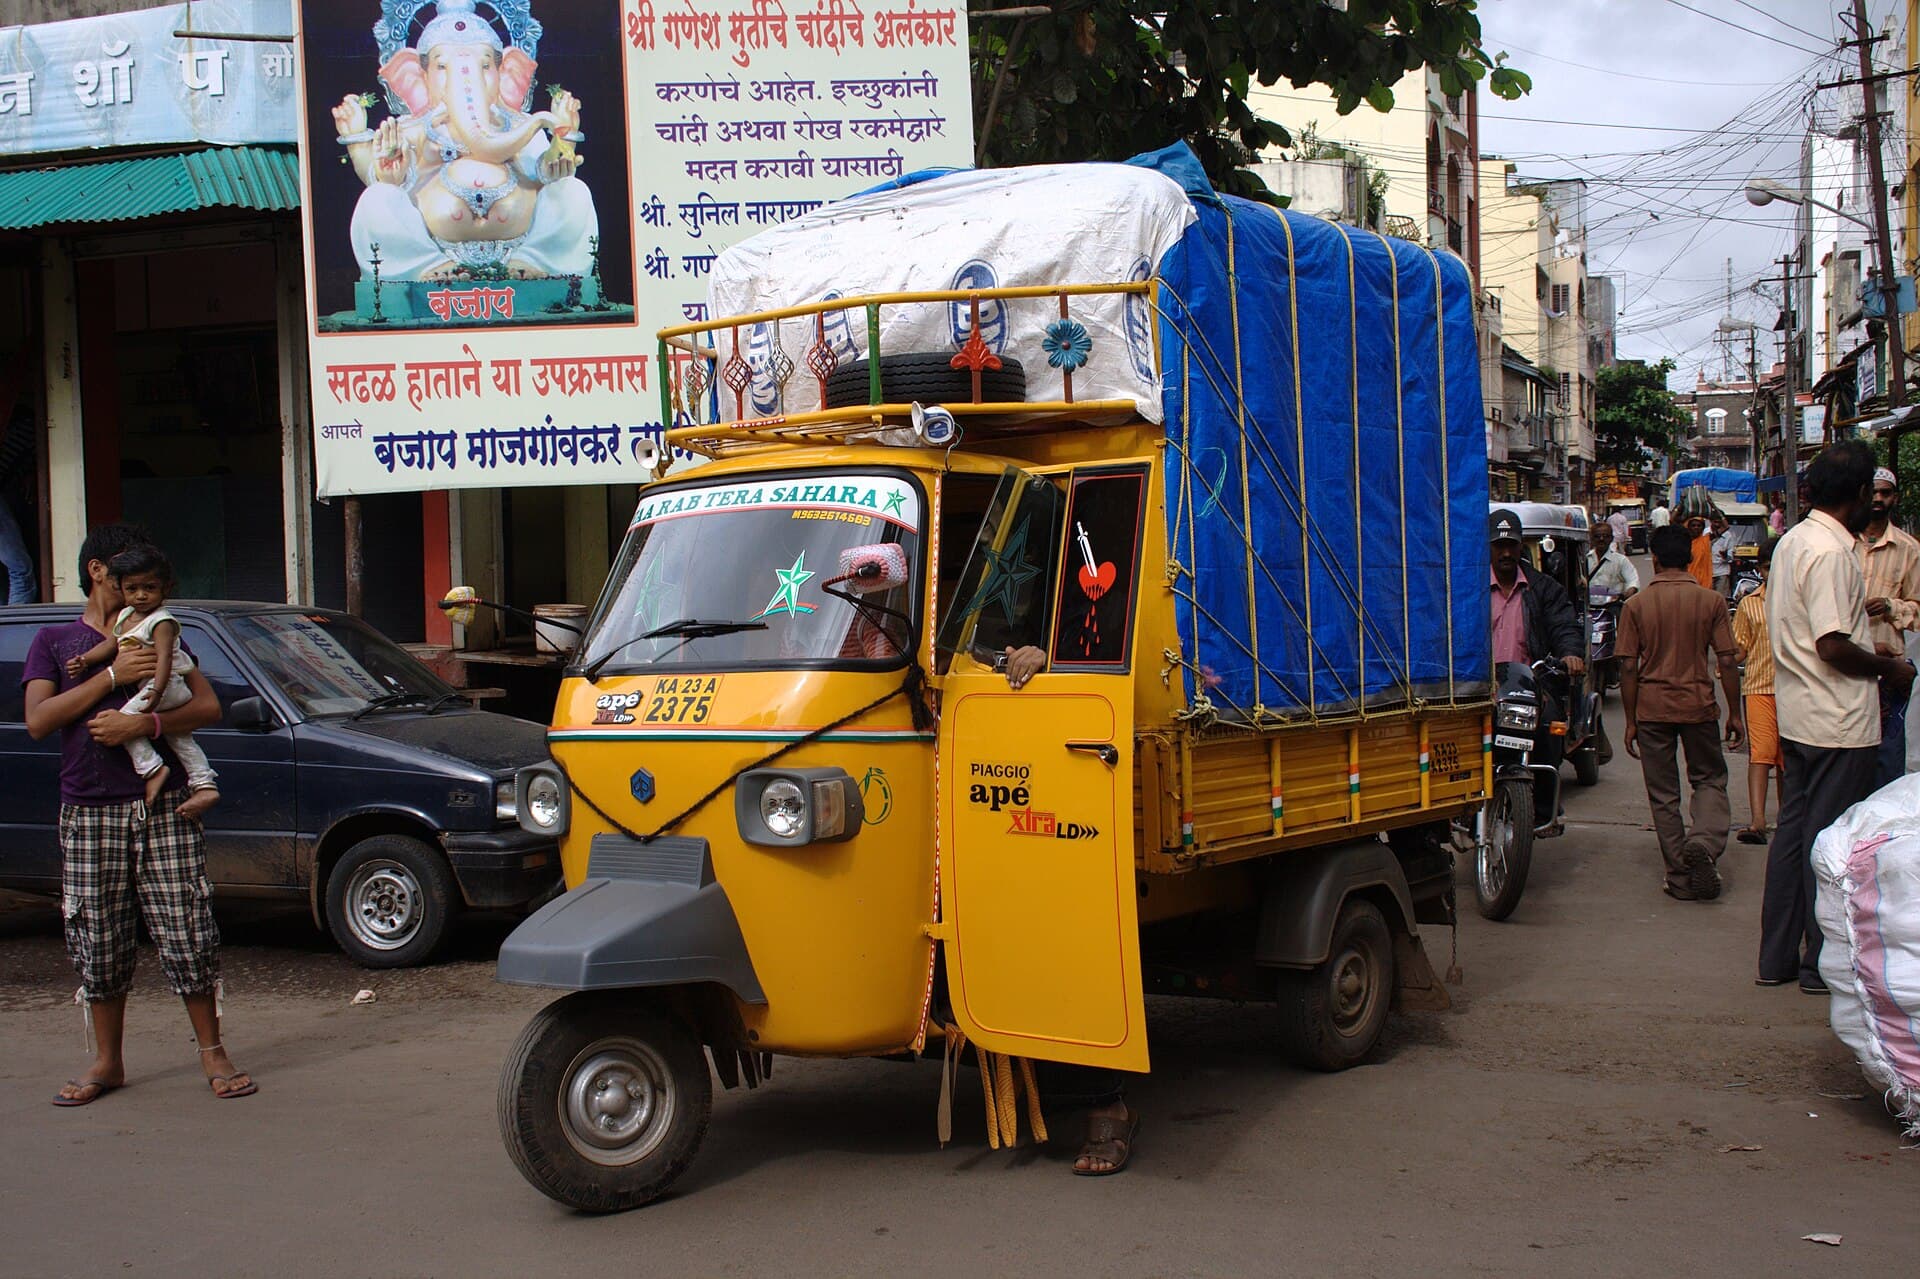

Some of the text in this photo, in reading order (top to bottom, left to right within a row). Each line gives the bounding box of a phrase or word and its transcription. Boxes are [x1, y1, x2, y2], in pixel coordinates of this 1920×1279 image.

[628, 0, 655, 50] श्री
[663, 0, 721, 50] गणेश
[795, 0, 864, 56] चांदीचे
[873, 0, 956, 48] अलंकार
[655, 70, 938, 108] करणेचे आहेत. इच्छुकांनी
[655, 107, 946, 146] चांदी अथवा रोख रकमेद्वारे
[685, 148, 904, 183] मदत करावी यासाठी
[640, 194, 671, 227] श्री.
[678, 192, 740, 238] सुनिल
[644, 246, 675, 279] श्री.
[427, 287, 515, 321] बजाप
[326, 363, 396, 404] सढळ
[405, 344, 482, 412] हाताने
[490, 359, 522, 396] या
[531, 354, 648, 396] उपक्रमास
[321, 419, 363, 440] आपले
[373, 429, 457, 473] बजाप
[466, 414, 622, 467] माजगांवकर
[655, 495, 703, 516] RAB
[704, 488, 763, 508] TERA
[769, 485, 878, 508] SAHARA
[655, 679, 678, 694] KA
[681, 679, 702, 694] 23
[645, 696, 711, 723] 2375
[971, 763, 1030, 779] PIAGGIO
[970, 780, 1030, 812] apé
